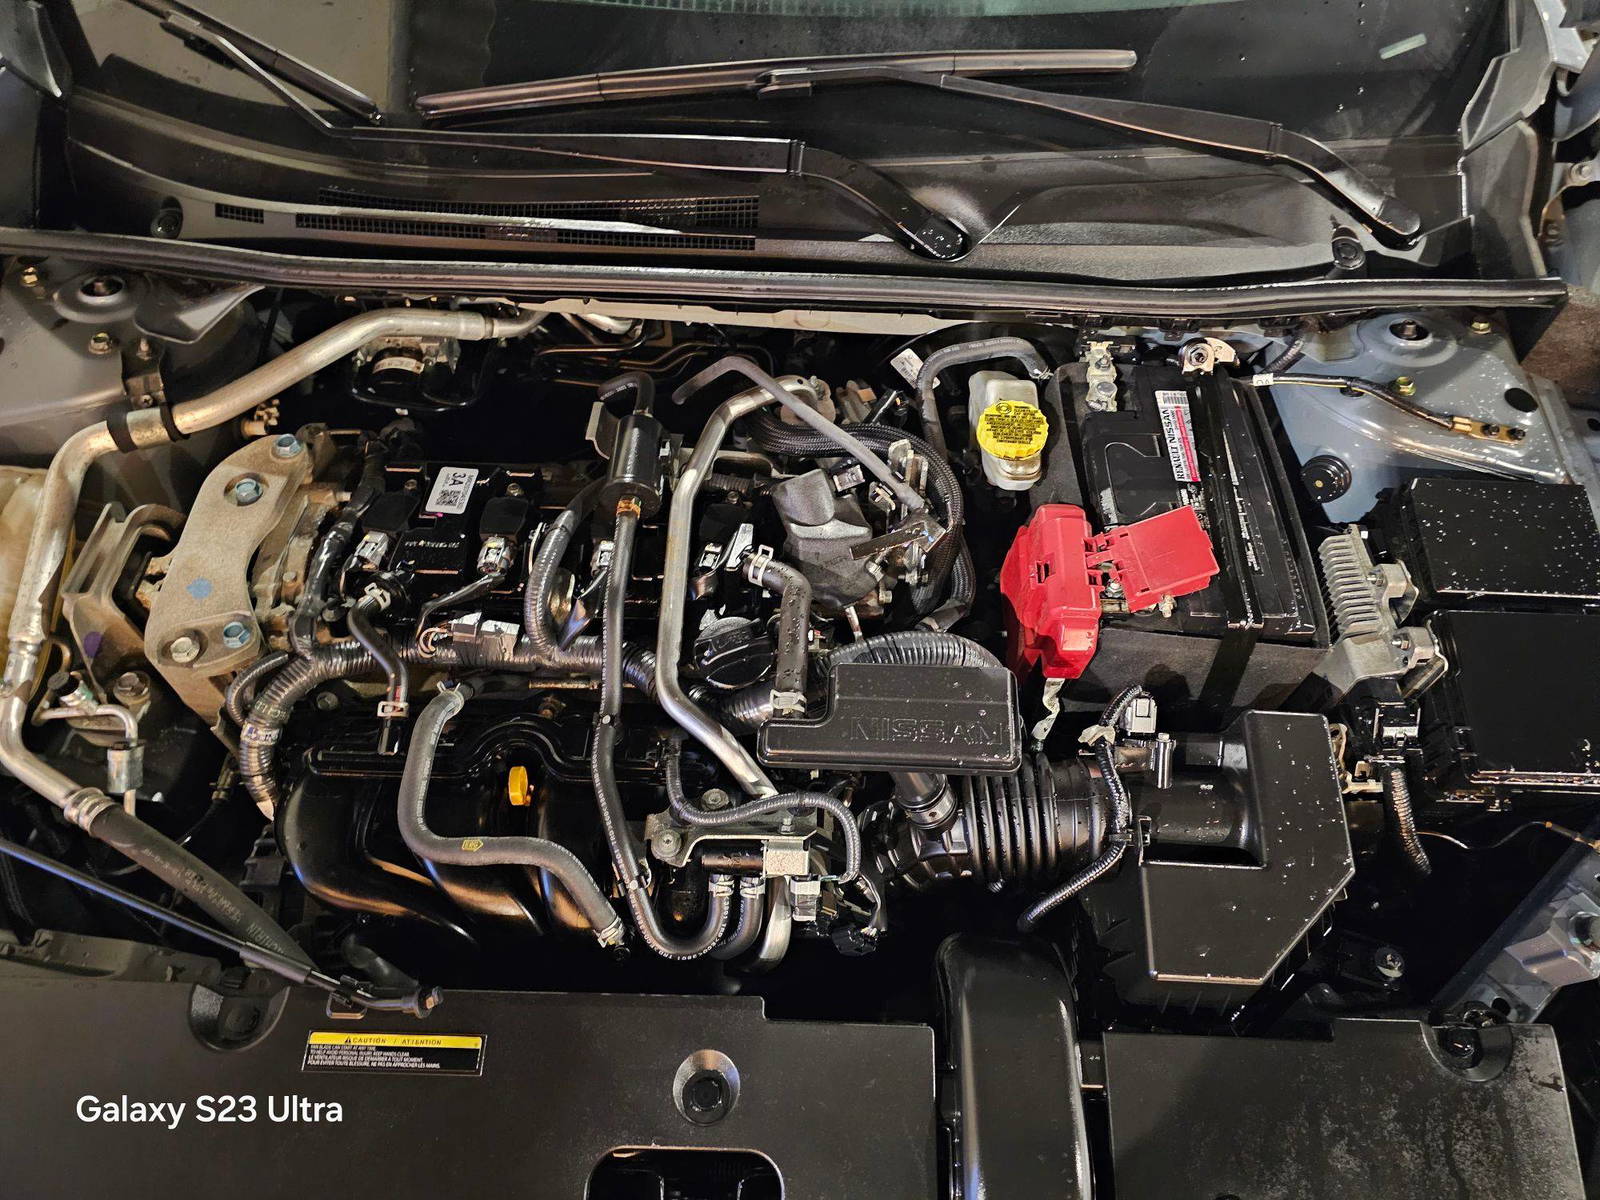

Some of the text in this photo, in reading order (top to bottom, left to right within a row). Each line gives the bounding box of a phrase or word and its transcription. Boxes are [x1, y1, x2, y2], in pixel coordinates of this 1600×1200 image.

[1161, 409, 1176, 444] NISSAN
[1170, 446, 1185, 480] RENAULT
[449, 472, 467, 486] 3A
[850, 716, 1003, 745] NISSAN
[353, 1036, 386, 1044] CAUTION
